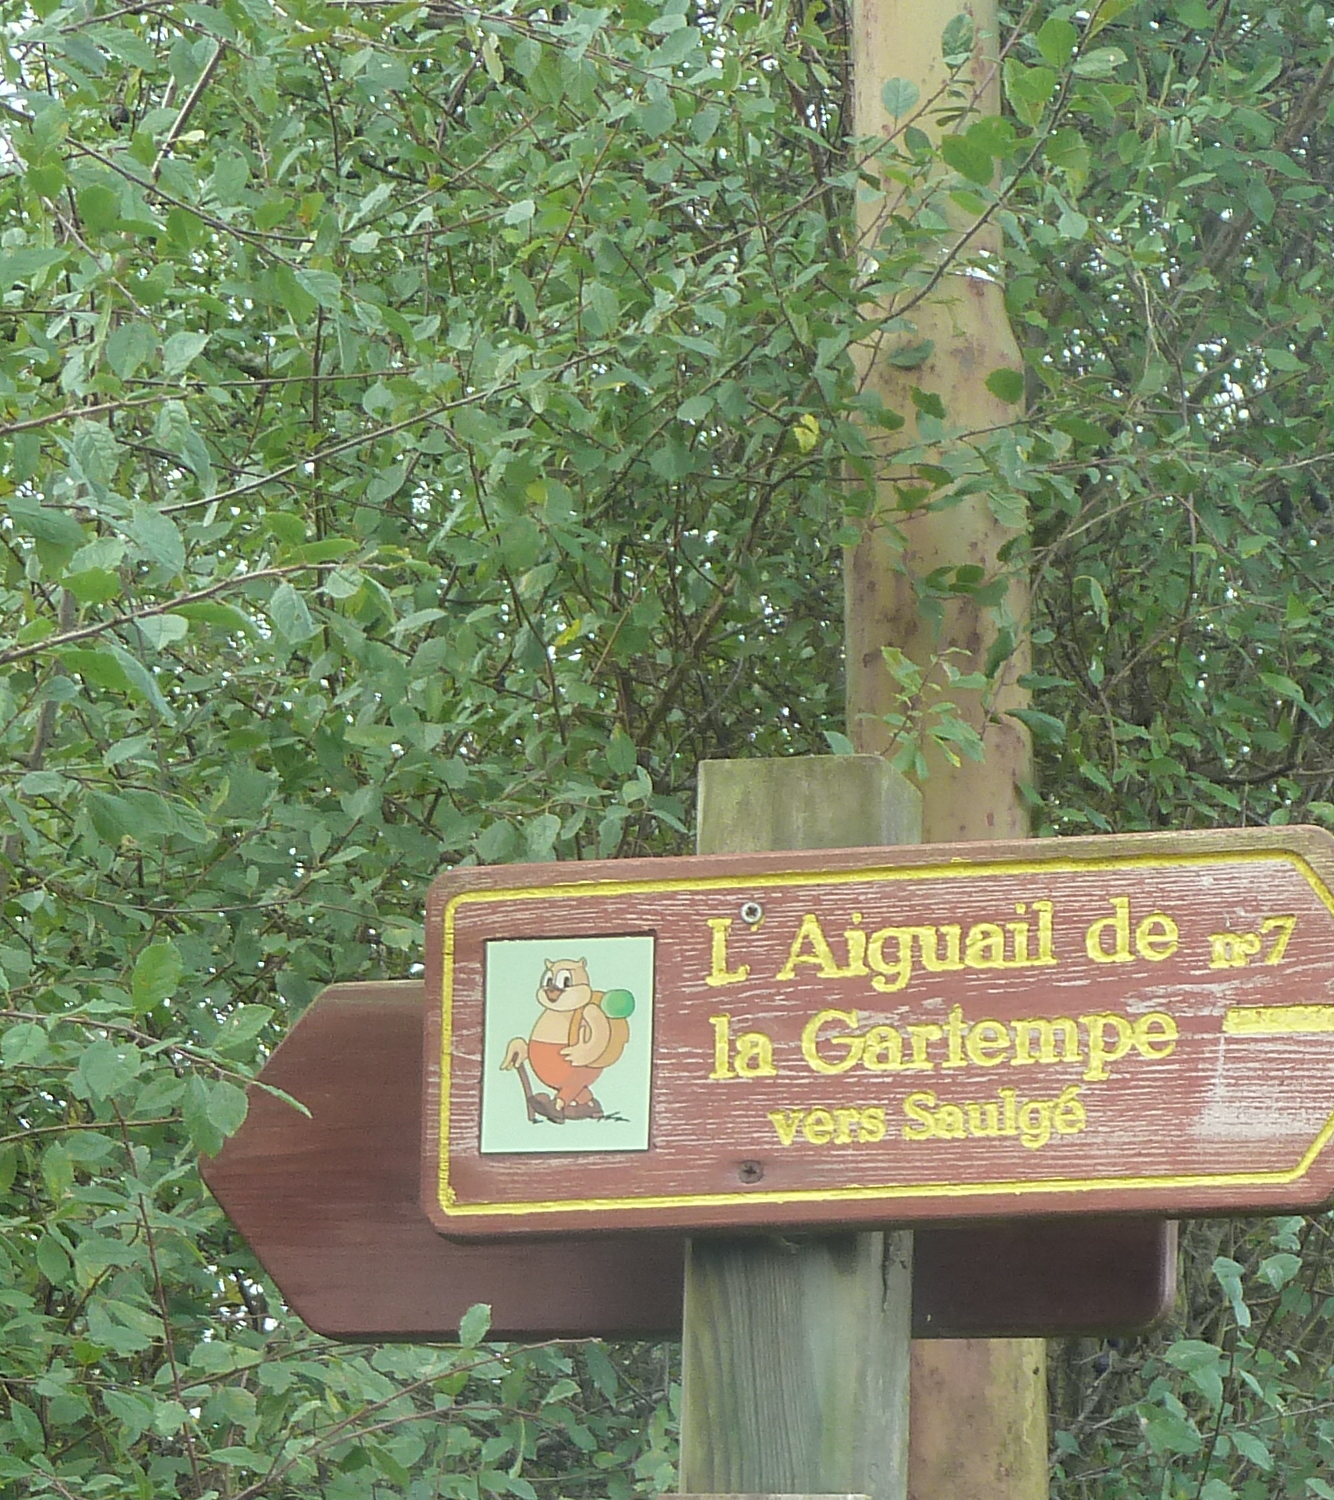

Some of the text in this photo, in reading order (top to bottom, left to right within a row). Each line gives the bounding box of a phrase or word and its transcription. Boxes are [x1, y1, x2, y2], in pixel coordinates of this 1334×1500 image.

[1085, 895, 1180, 963] de
[708, 1003, 1180, 1081] la Gartempe
[768, 1083, 1088, 1150] vers Saulgé
